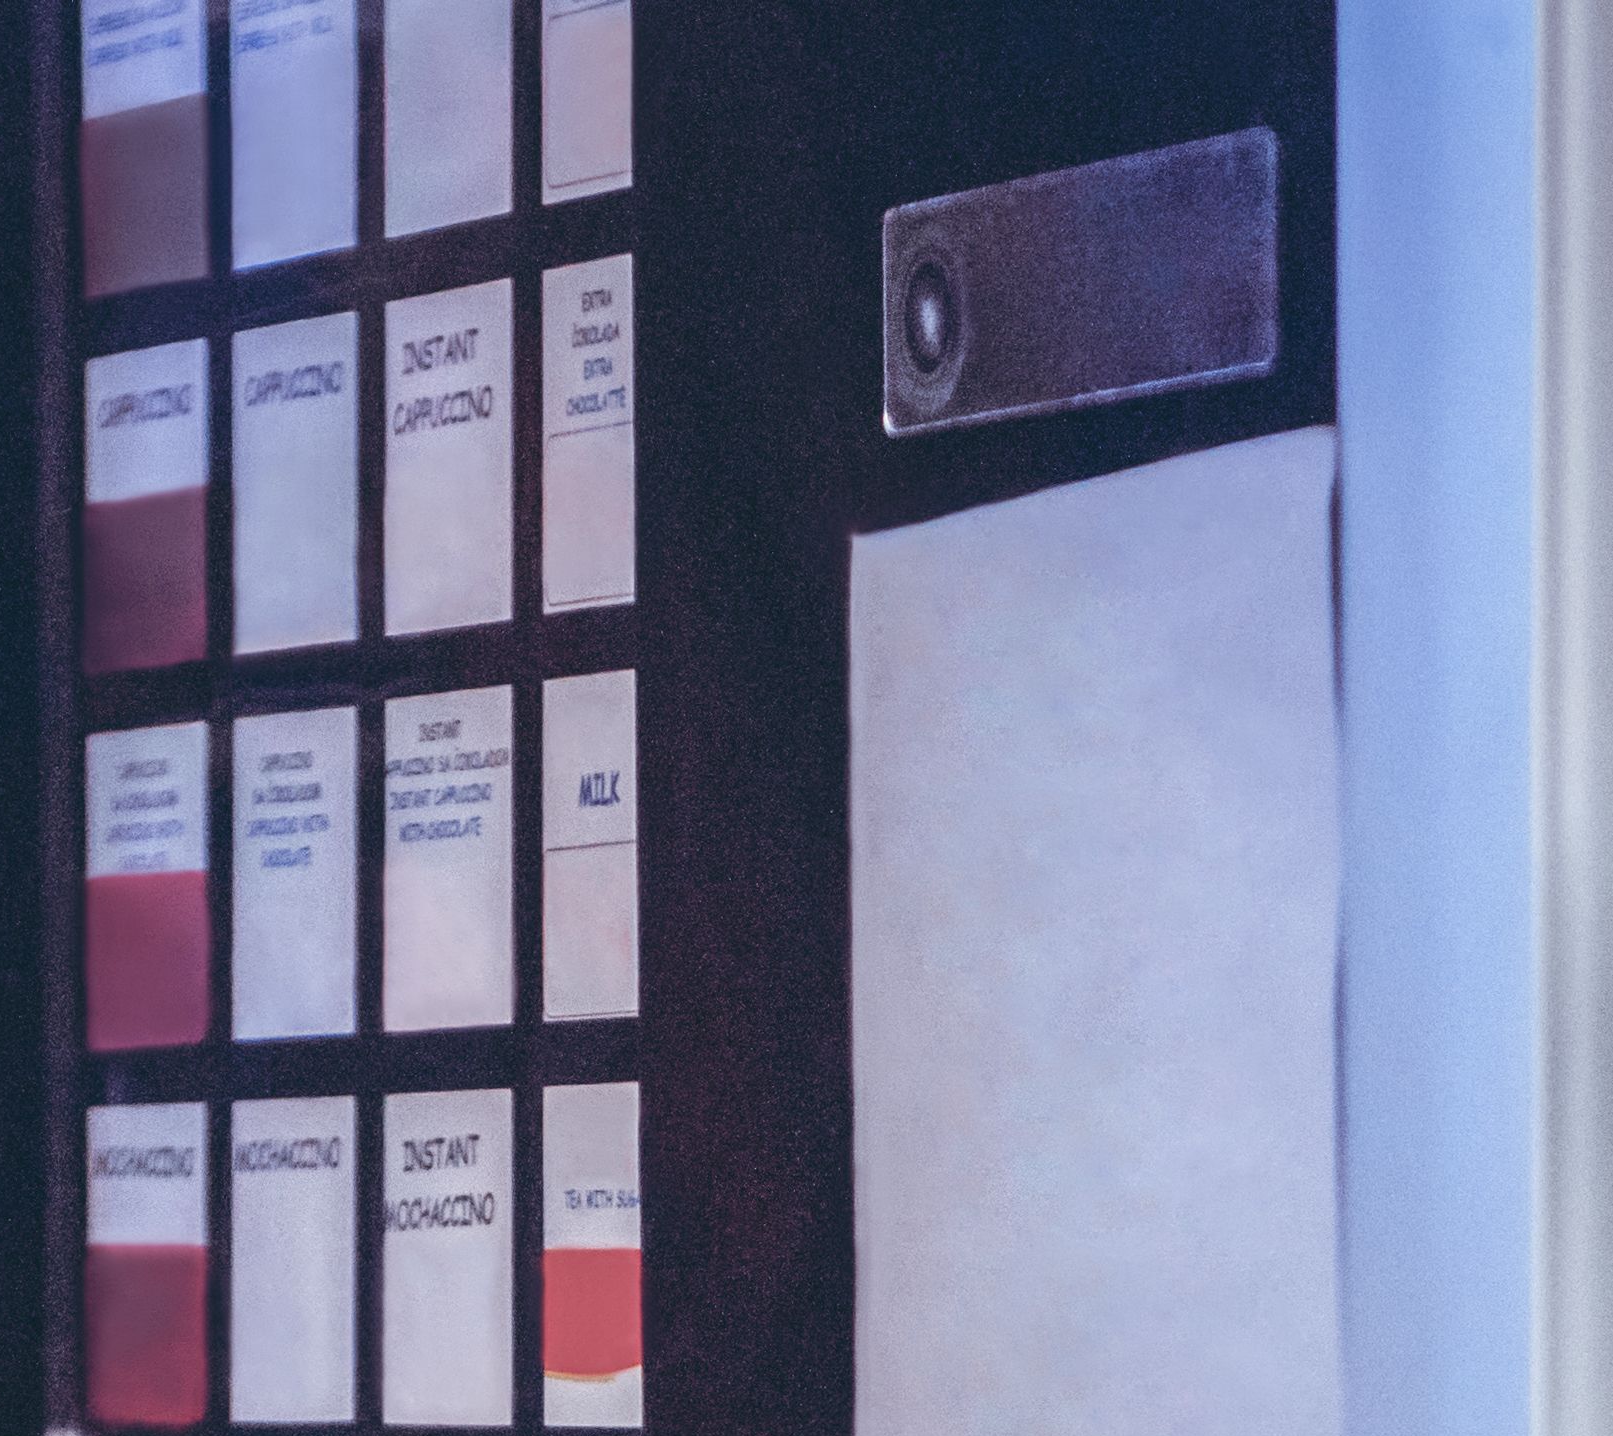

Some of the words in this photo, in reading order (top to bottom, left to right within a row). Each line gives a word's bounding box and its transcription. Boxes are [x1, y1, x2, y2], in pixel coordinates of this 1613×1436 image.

[402, 329, 478, 374] INSTANT
[245, 361, 344, 407] CAPPUCCINO
[393, 386, 493, 435] CAPPUCCINO
[579, 771, 620, 806] MILK
[403, 1134, 480, 1171] INSTANT
